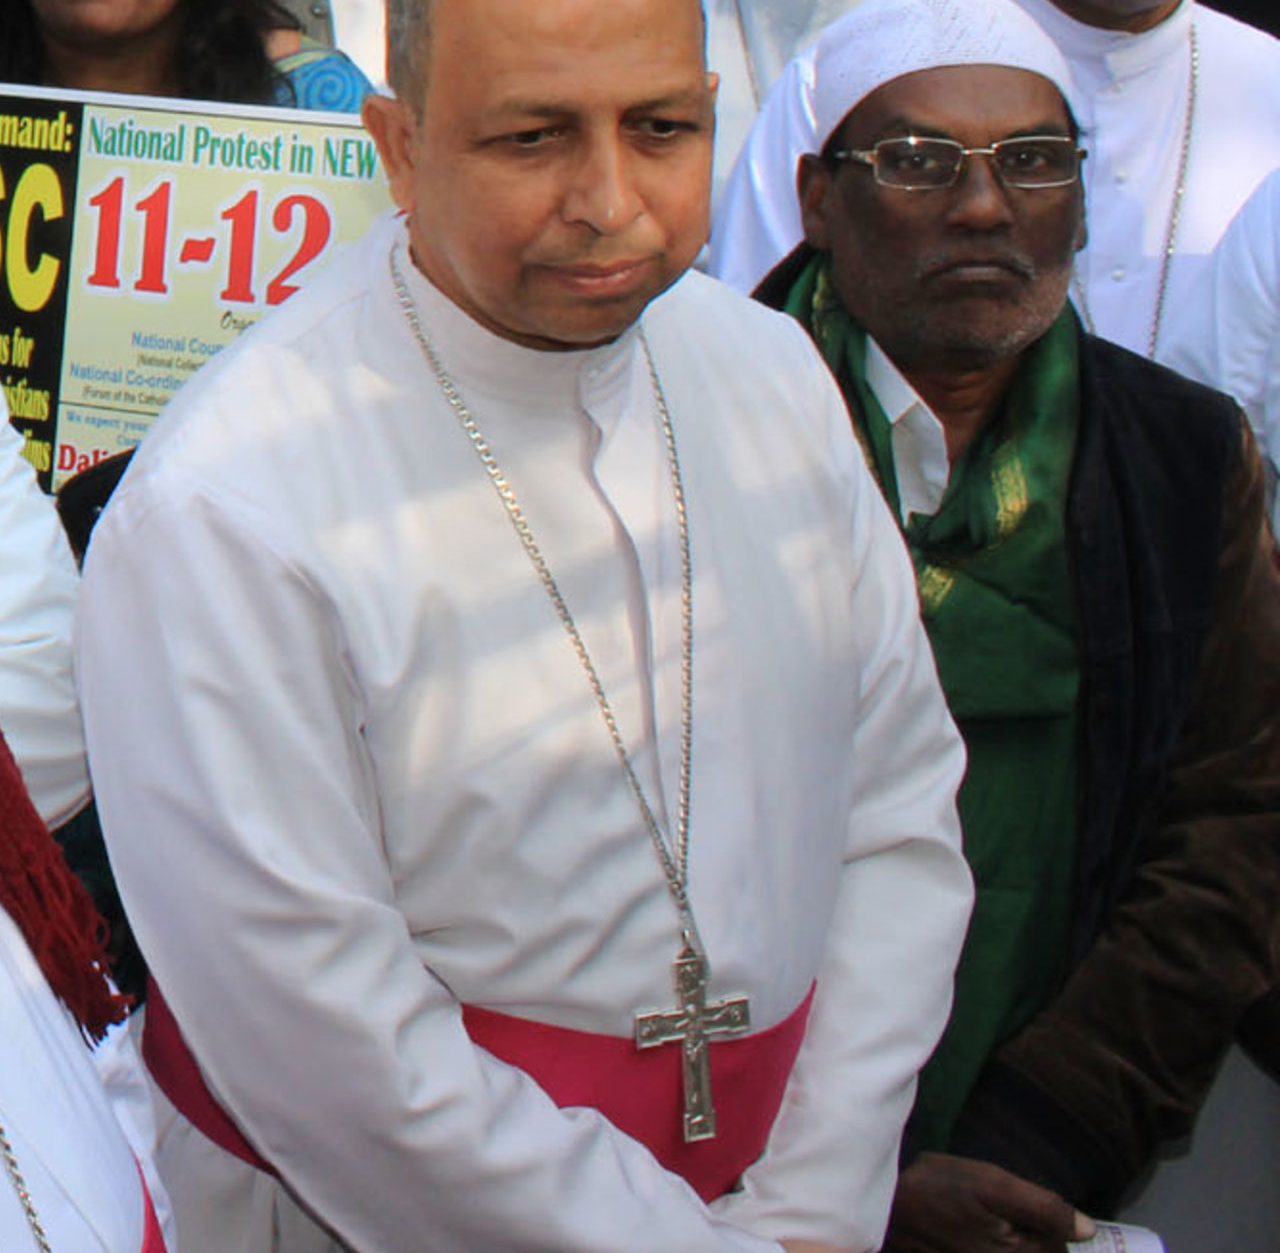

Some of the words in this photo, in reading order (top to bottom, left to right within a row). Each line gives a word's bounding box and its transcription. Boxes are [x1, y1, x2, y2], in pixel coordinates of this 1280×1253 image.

[89, 116, 185, 162] National
[193, 125, 282, 171] Protest
[290, 133, 313, 174] in
[323, 136, 377, 179] NEW
[87, 176, 331, 305] 11-12
[12, 326, 35, 368] for
[132, 331, 186, 354] National
[70, 362, 122, 383] National
